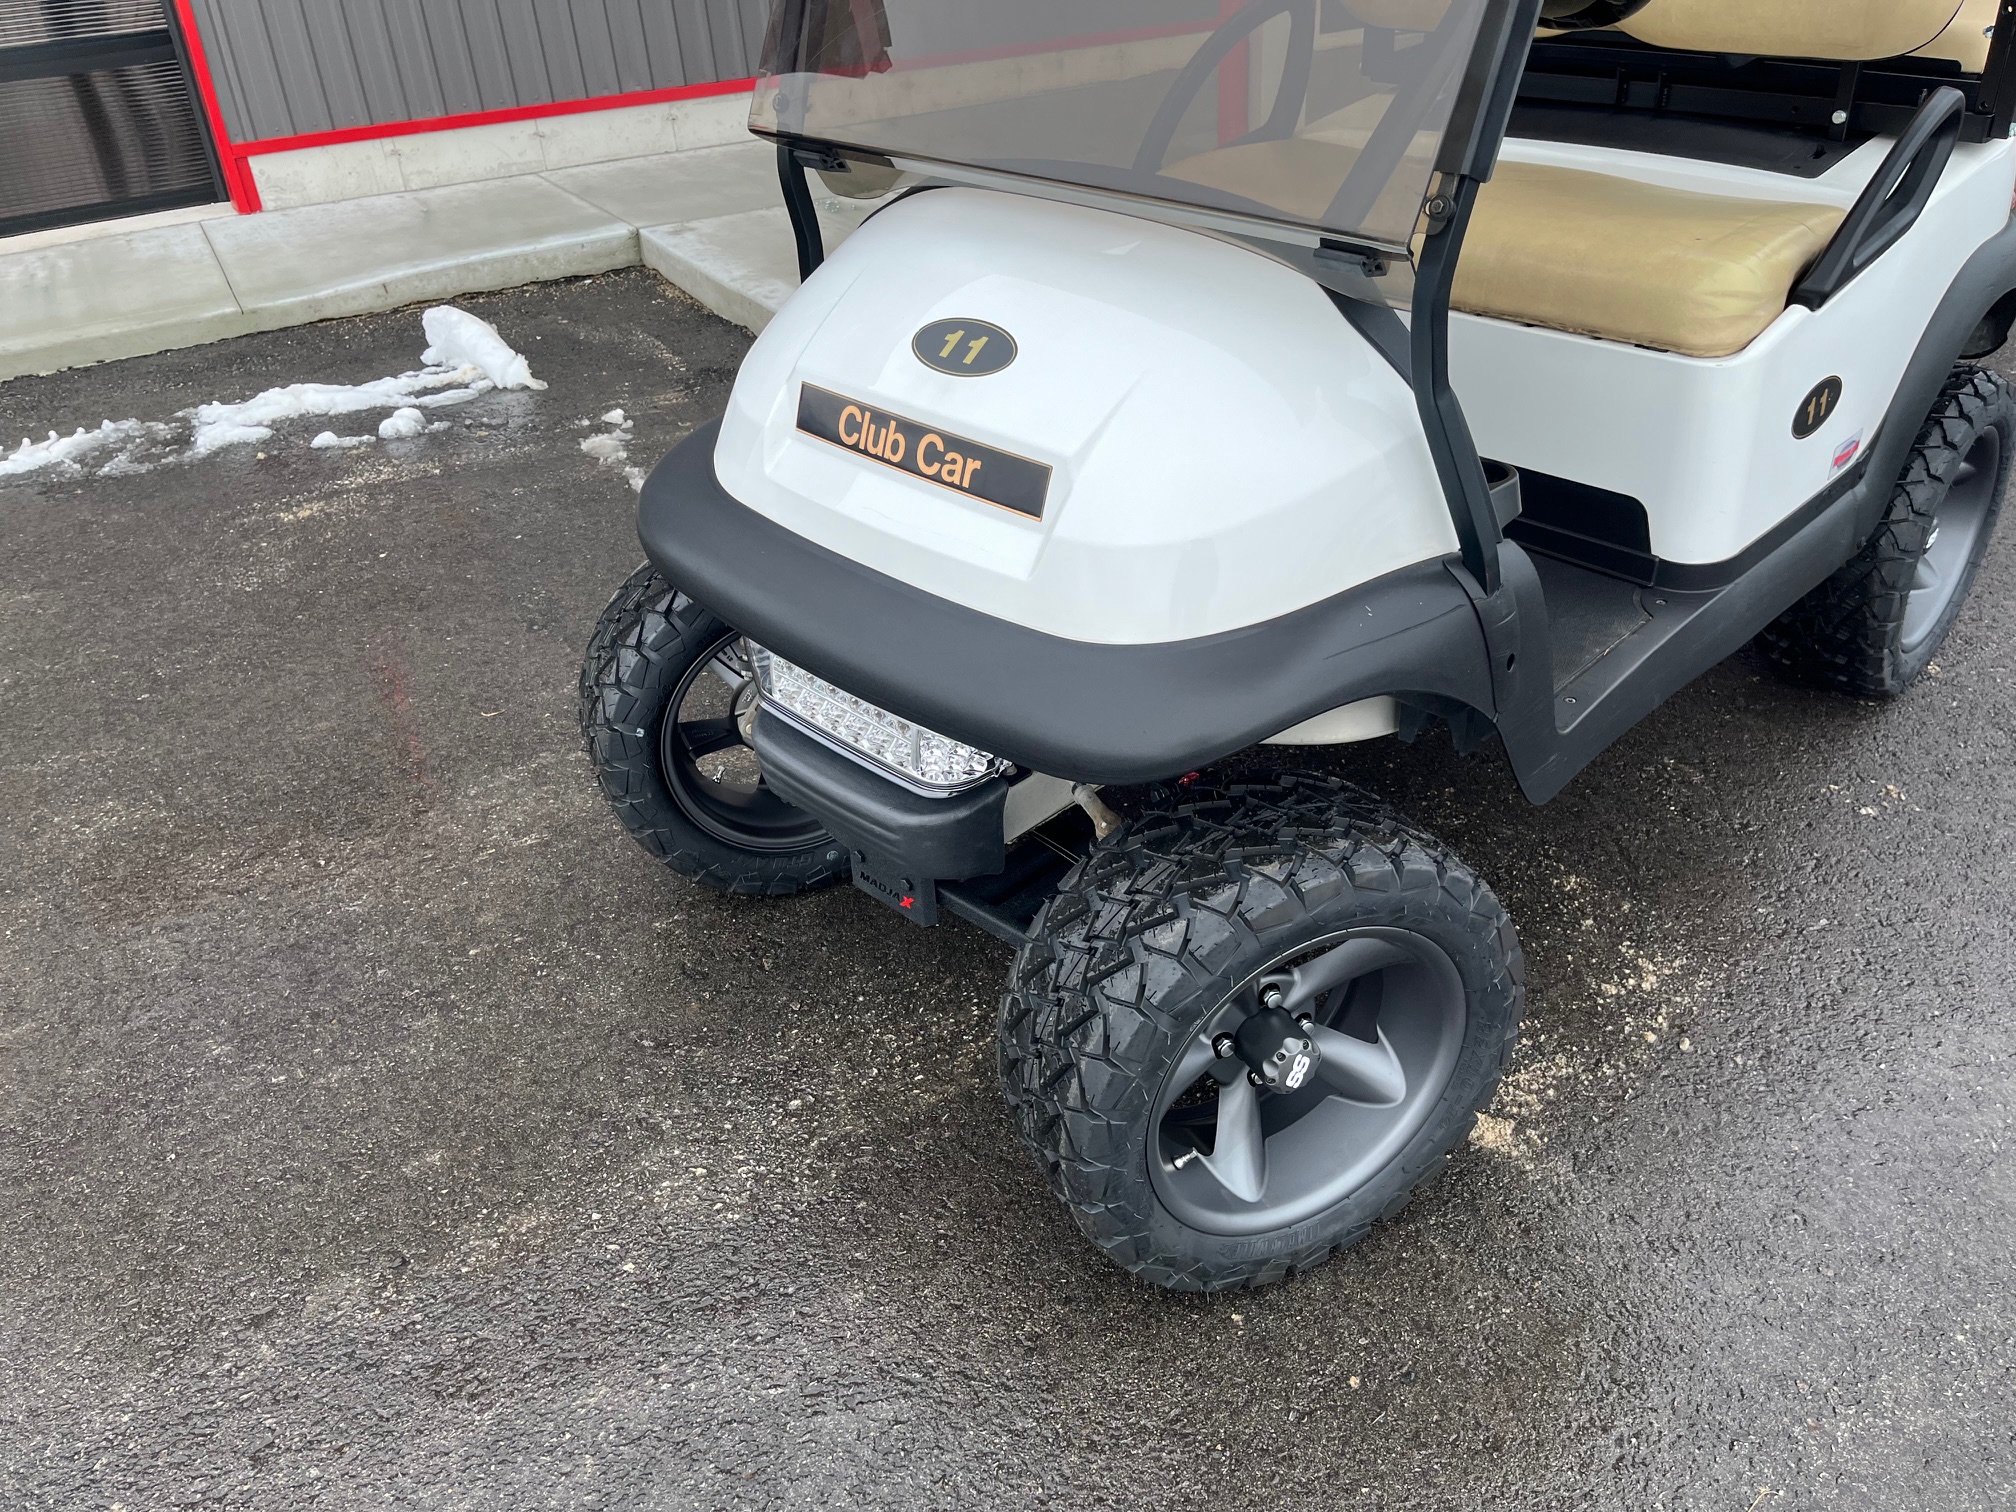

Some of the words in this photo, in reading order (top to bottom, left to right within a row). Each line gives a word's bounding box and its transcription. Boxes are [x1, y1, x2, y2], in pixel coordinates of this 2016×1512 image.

[939, 329, 989, 365] 11
[1807, 388, 1829, 426] 11
[838, 405, 906, 463] Club
[916, 433, 982, 489] Car
